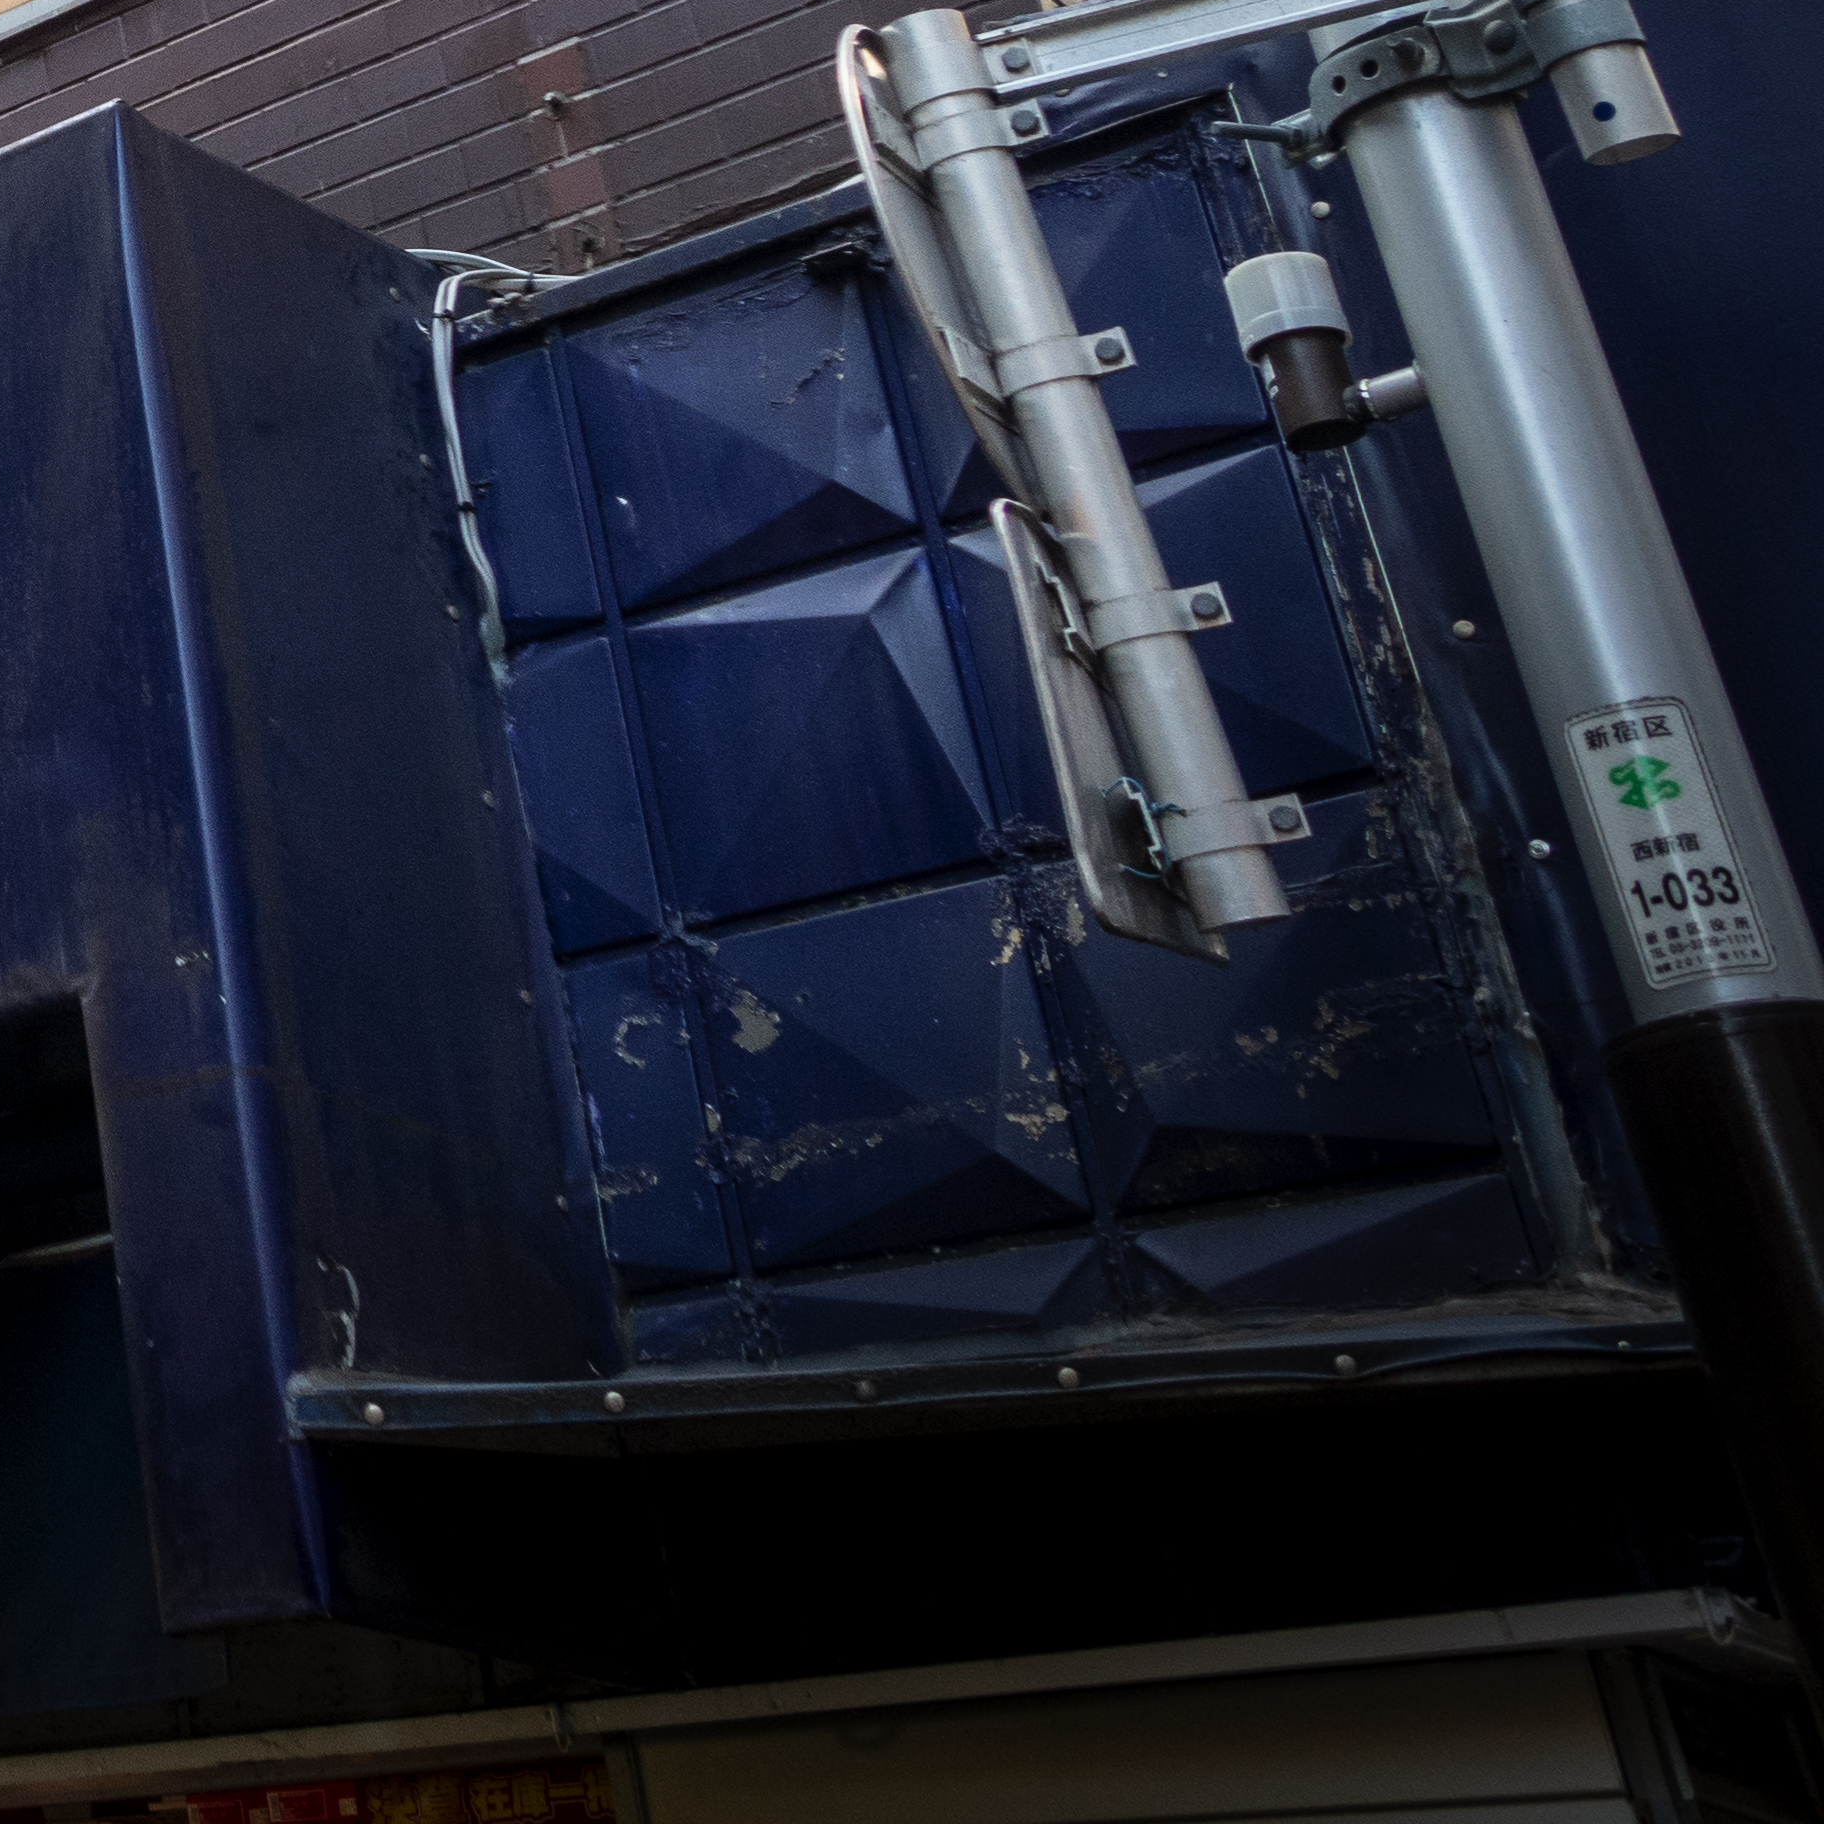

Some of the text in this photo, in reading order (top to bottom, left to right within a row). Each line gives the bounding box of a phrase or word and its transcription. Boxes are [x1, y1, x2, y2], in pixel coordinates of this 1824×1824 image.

[1583, 715, 1673, 750] 新宿区
[1630, 833, 1701, 862] 西新宿
[1631, 866, 1740, 918] 1-033
